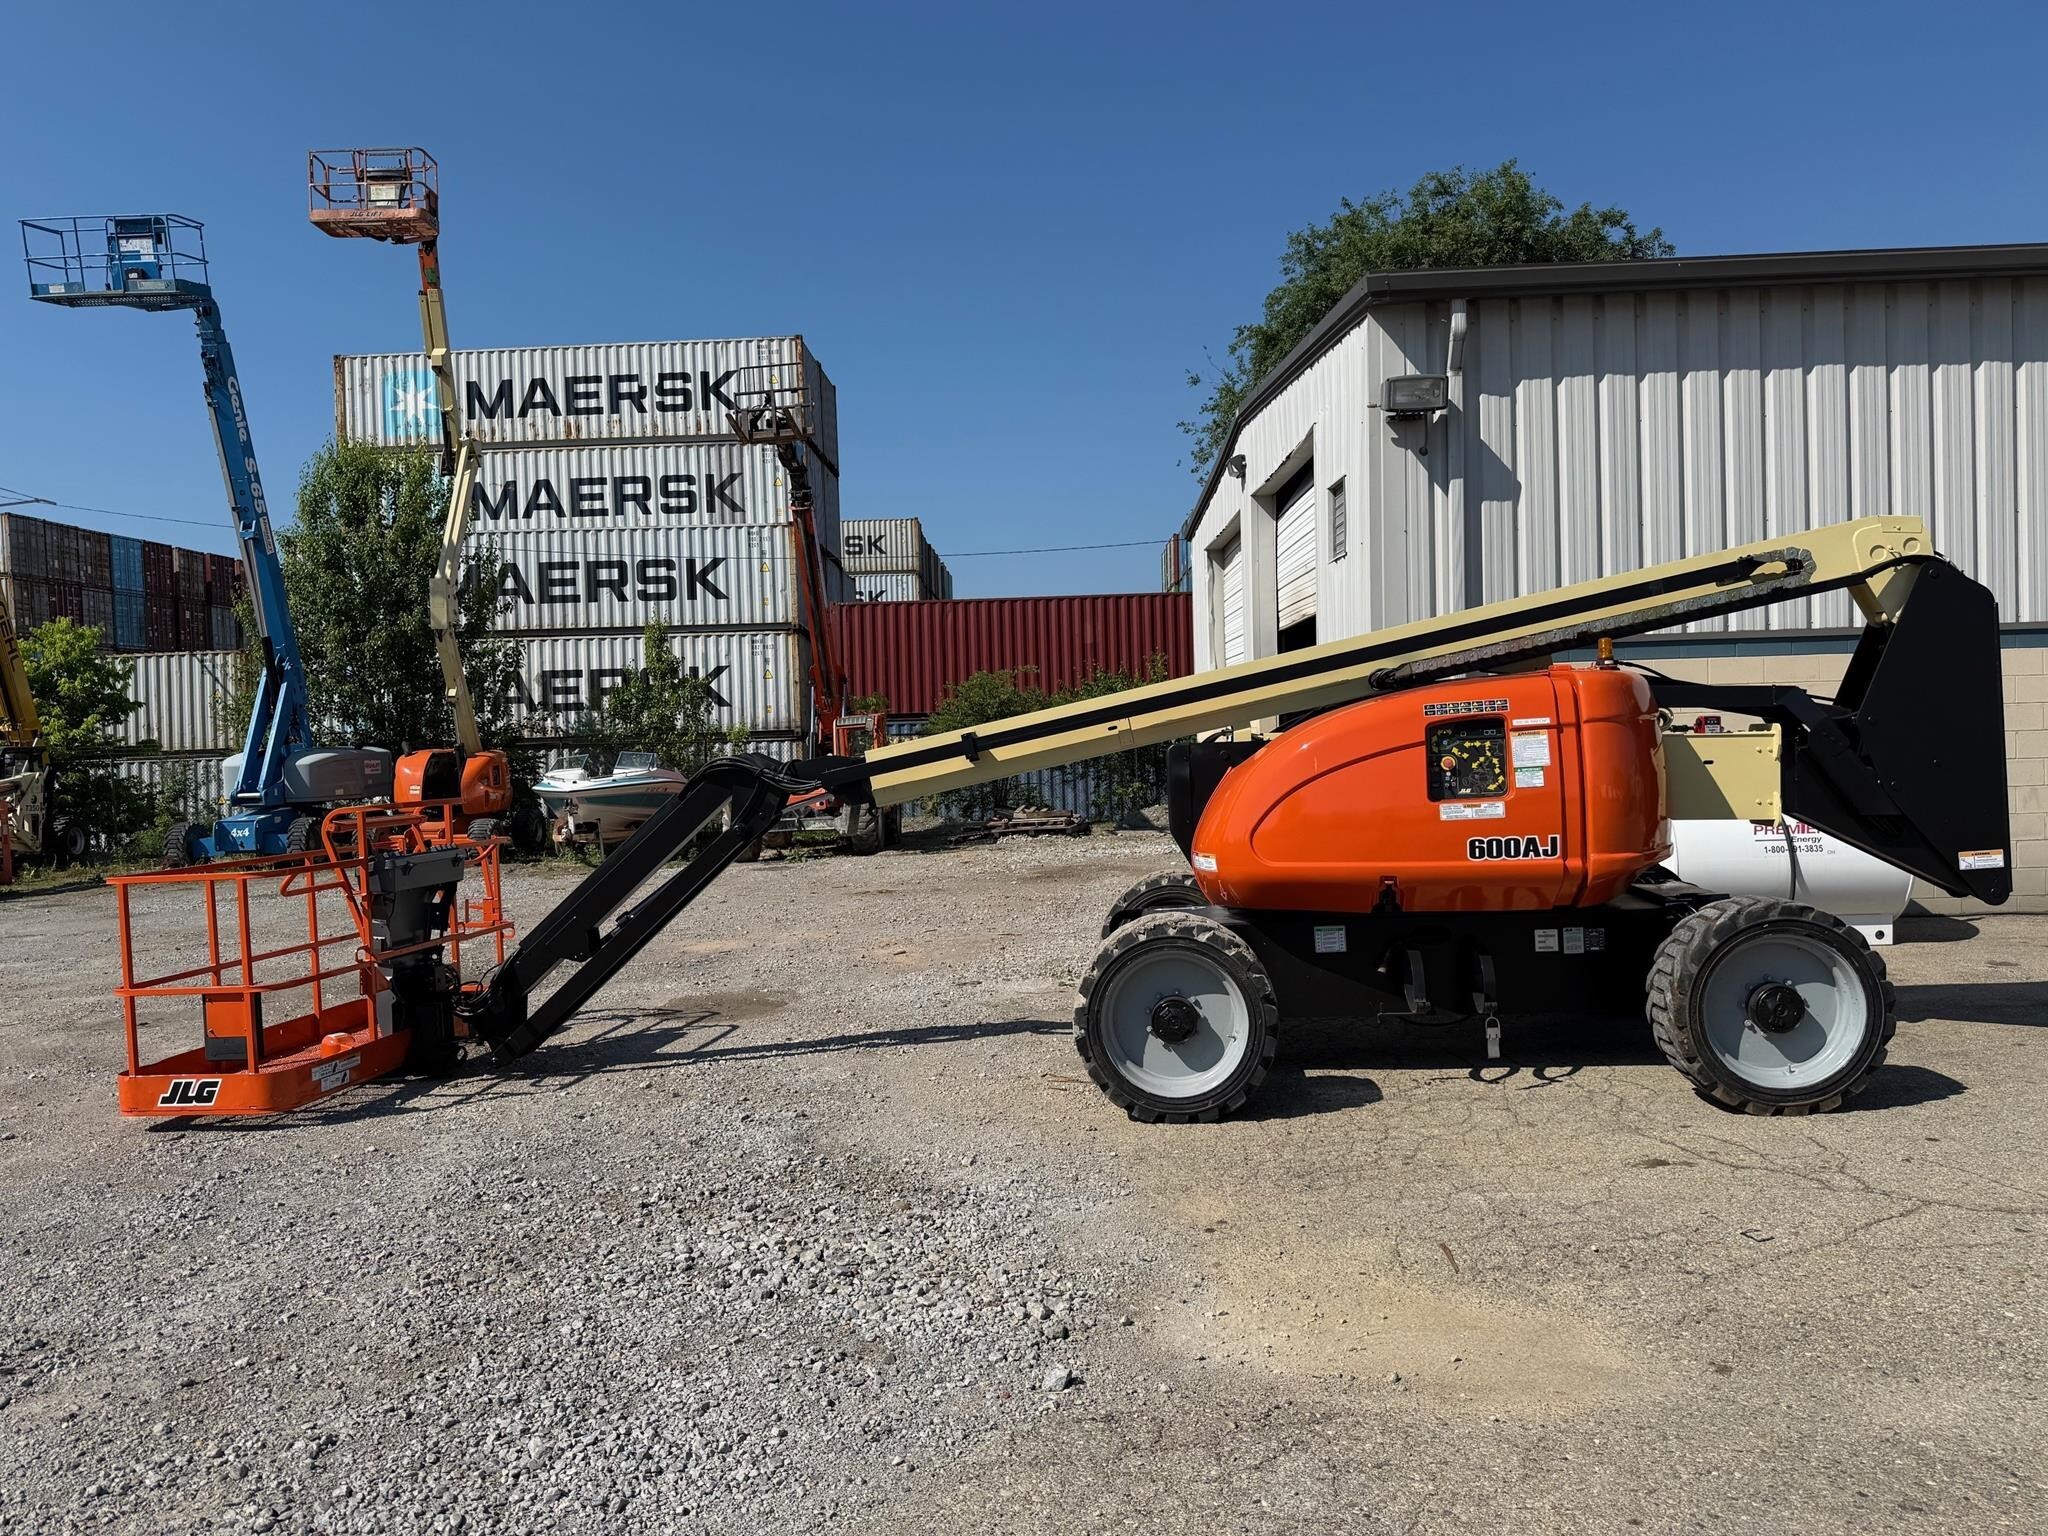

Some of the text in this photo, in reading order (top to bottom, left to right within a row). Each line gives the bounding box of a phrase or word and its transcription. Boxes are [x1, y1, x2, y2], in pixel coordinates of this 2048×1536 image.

[466, 370, 738, 420] MAERSK
[227, 376, 266, 514] Genie S-65
[472, 472, 745, 521] MAERSK
[845, 535, 887, 555] SK
[231, 828, 249, 837] 4x4
[1753, 822, 1821, 835] PREMIE
[1468, 836, 1558, 860] 600AJ
[1764, 844, 1823, 854] 1-800-91-3835
[1791, 836, 1822, 844] Energy
[159, 1080, 220, 1105] JLG
